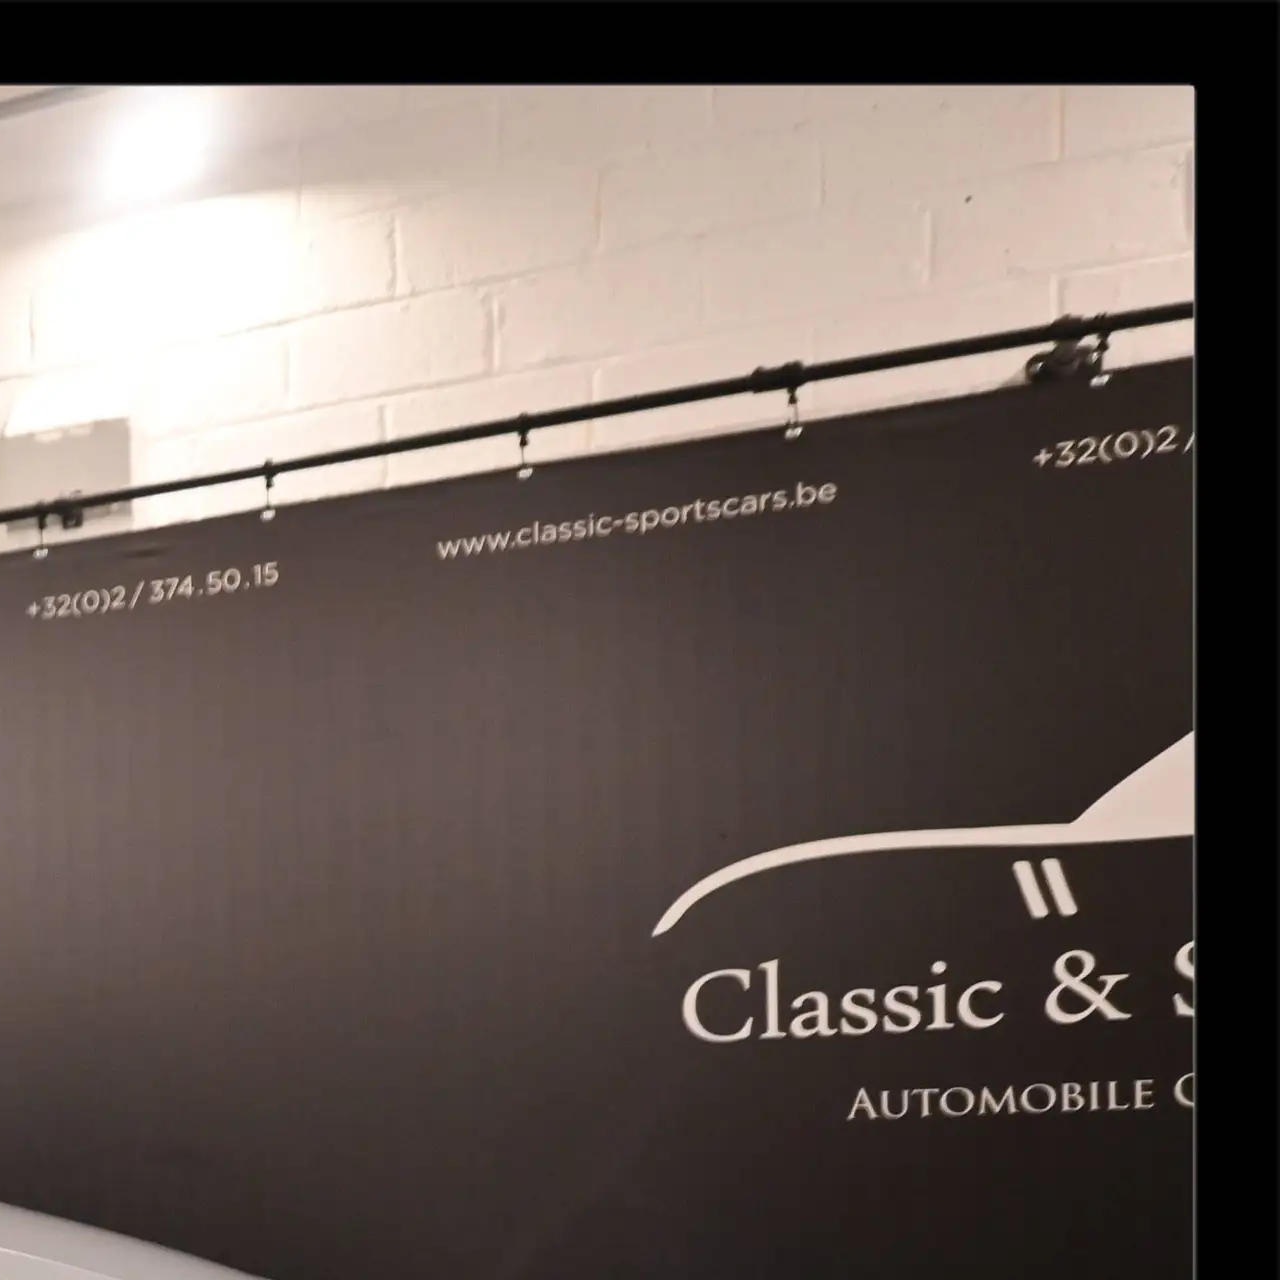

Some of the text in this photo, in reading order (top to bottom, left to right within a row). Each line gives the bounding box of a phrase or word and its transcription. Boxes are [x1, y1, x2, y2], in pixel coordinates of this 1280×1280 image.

[1031, 424, 1180, 469] +32(0)2
[436, 481, 838, 560] www.classic-sportscars.be
[682, 959, 1007, 1044] Classic
[1043, 949, 1133, 1025] &
[845, 1077, 1156, 1122] AUTOMOBILE
